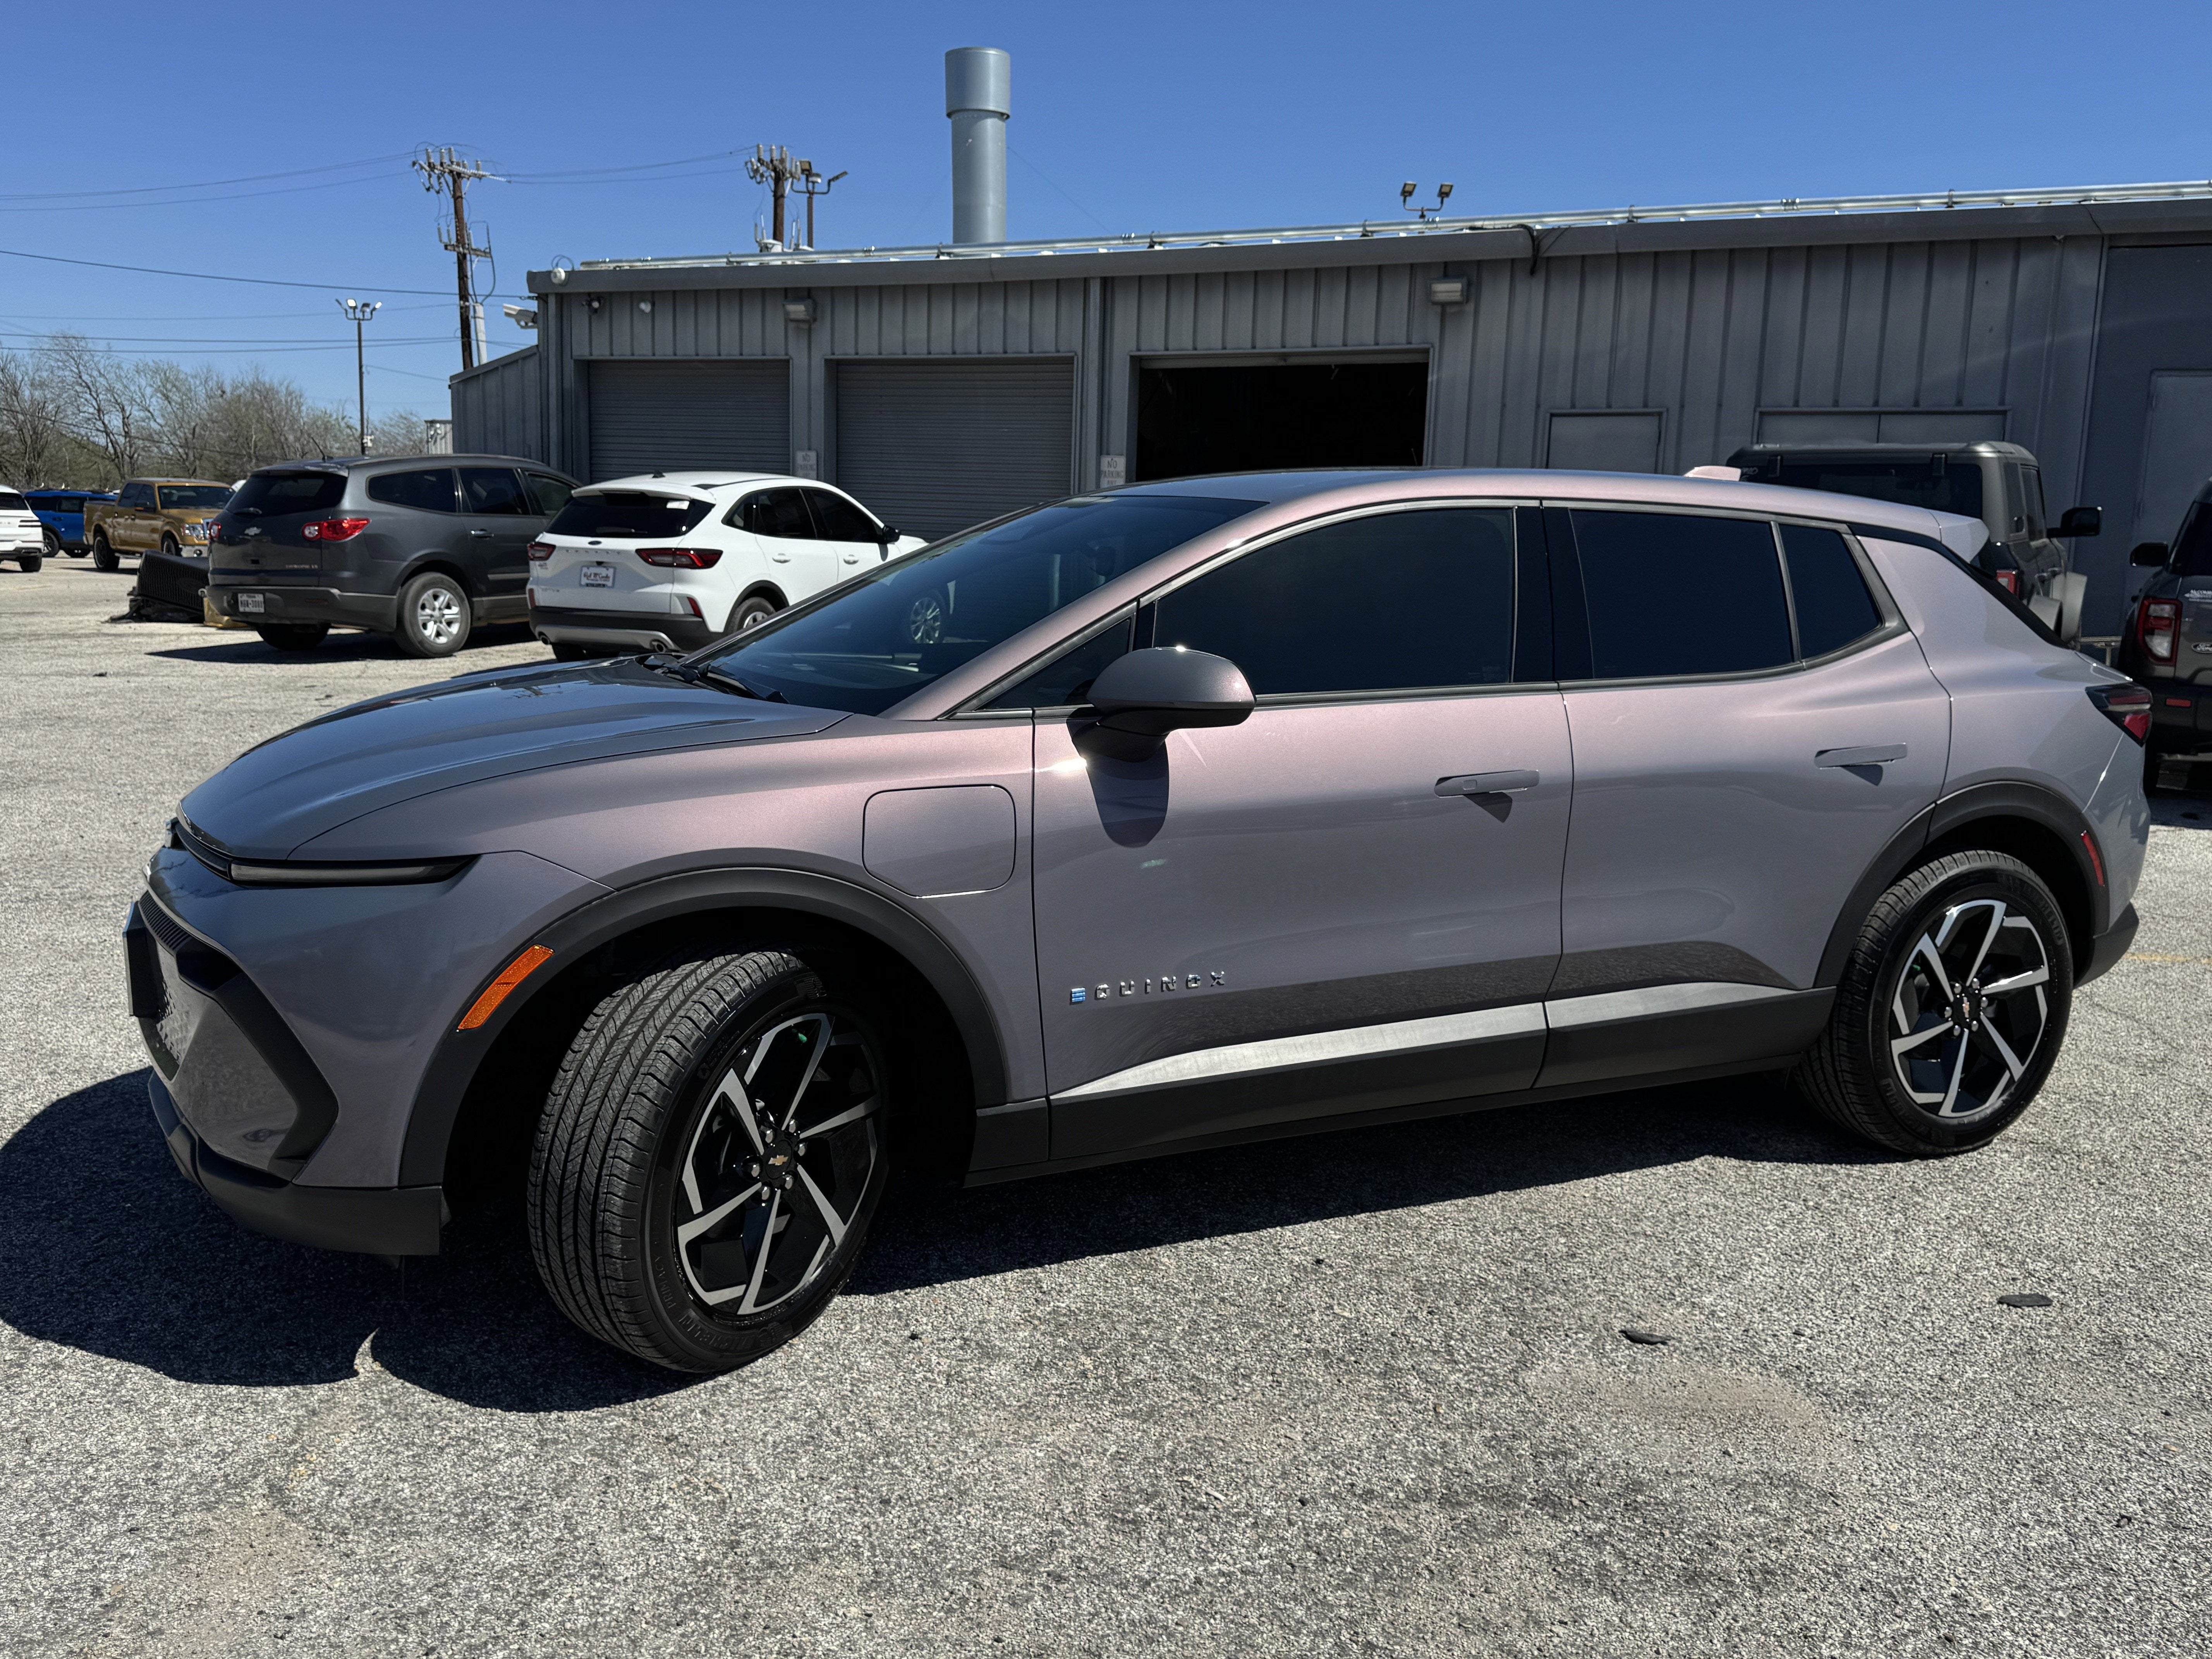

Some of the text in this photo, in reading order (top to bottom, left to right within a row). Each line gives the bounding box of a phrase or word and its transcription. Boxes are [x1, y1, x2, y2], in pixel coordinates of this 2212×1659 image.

[1108, 460, 1117, 469] NO
[1071, 971, 1225, 1003] EQUINOX
[654, 1253, 677, 1309] PRIMACY
